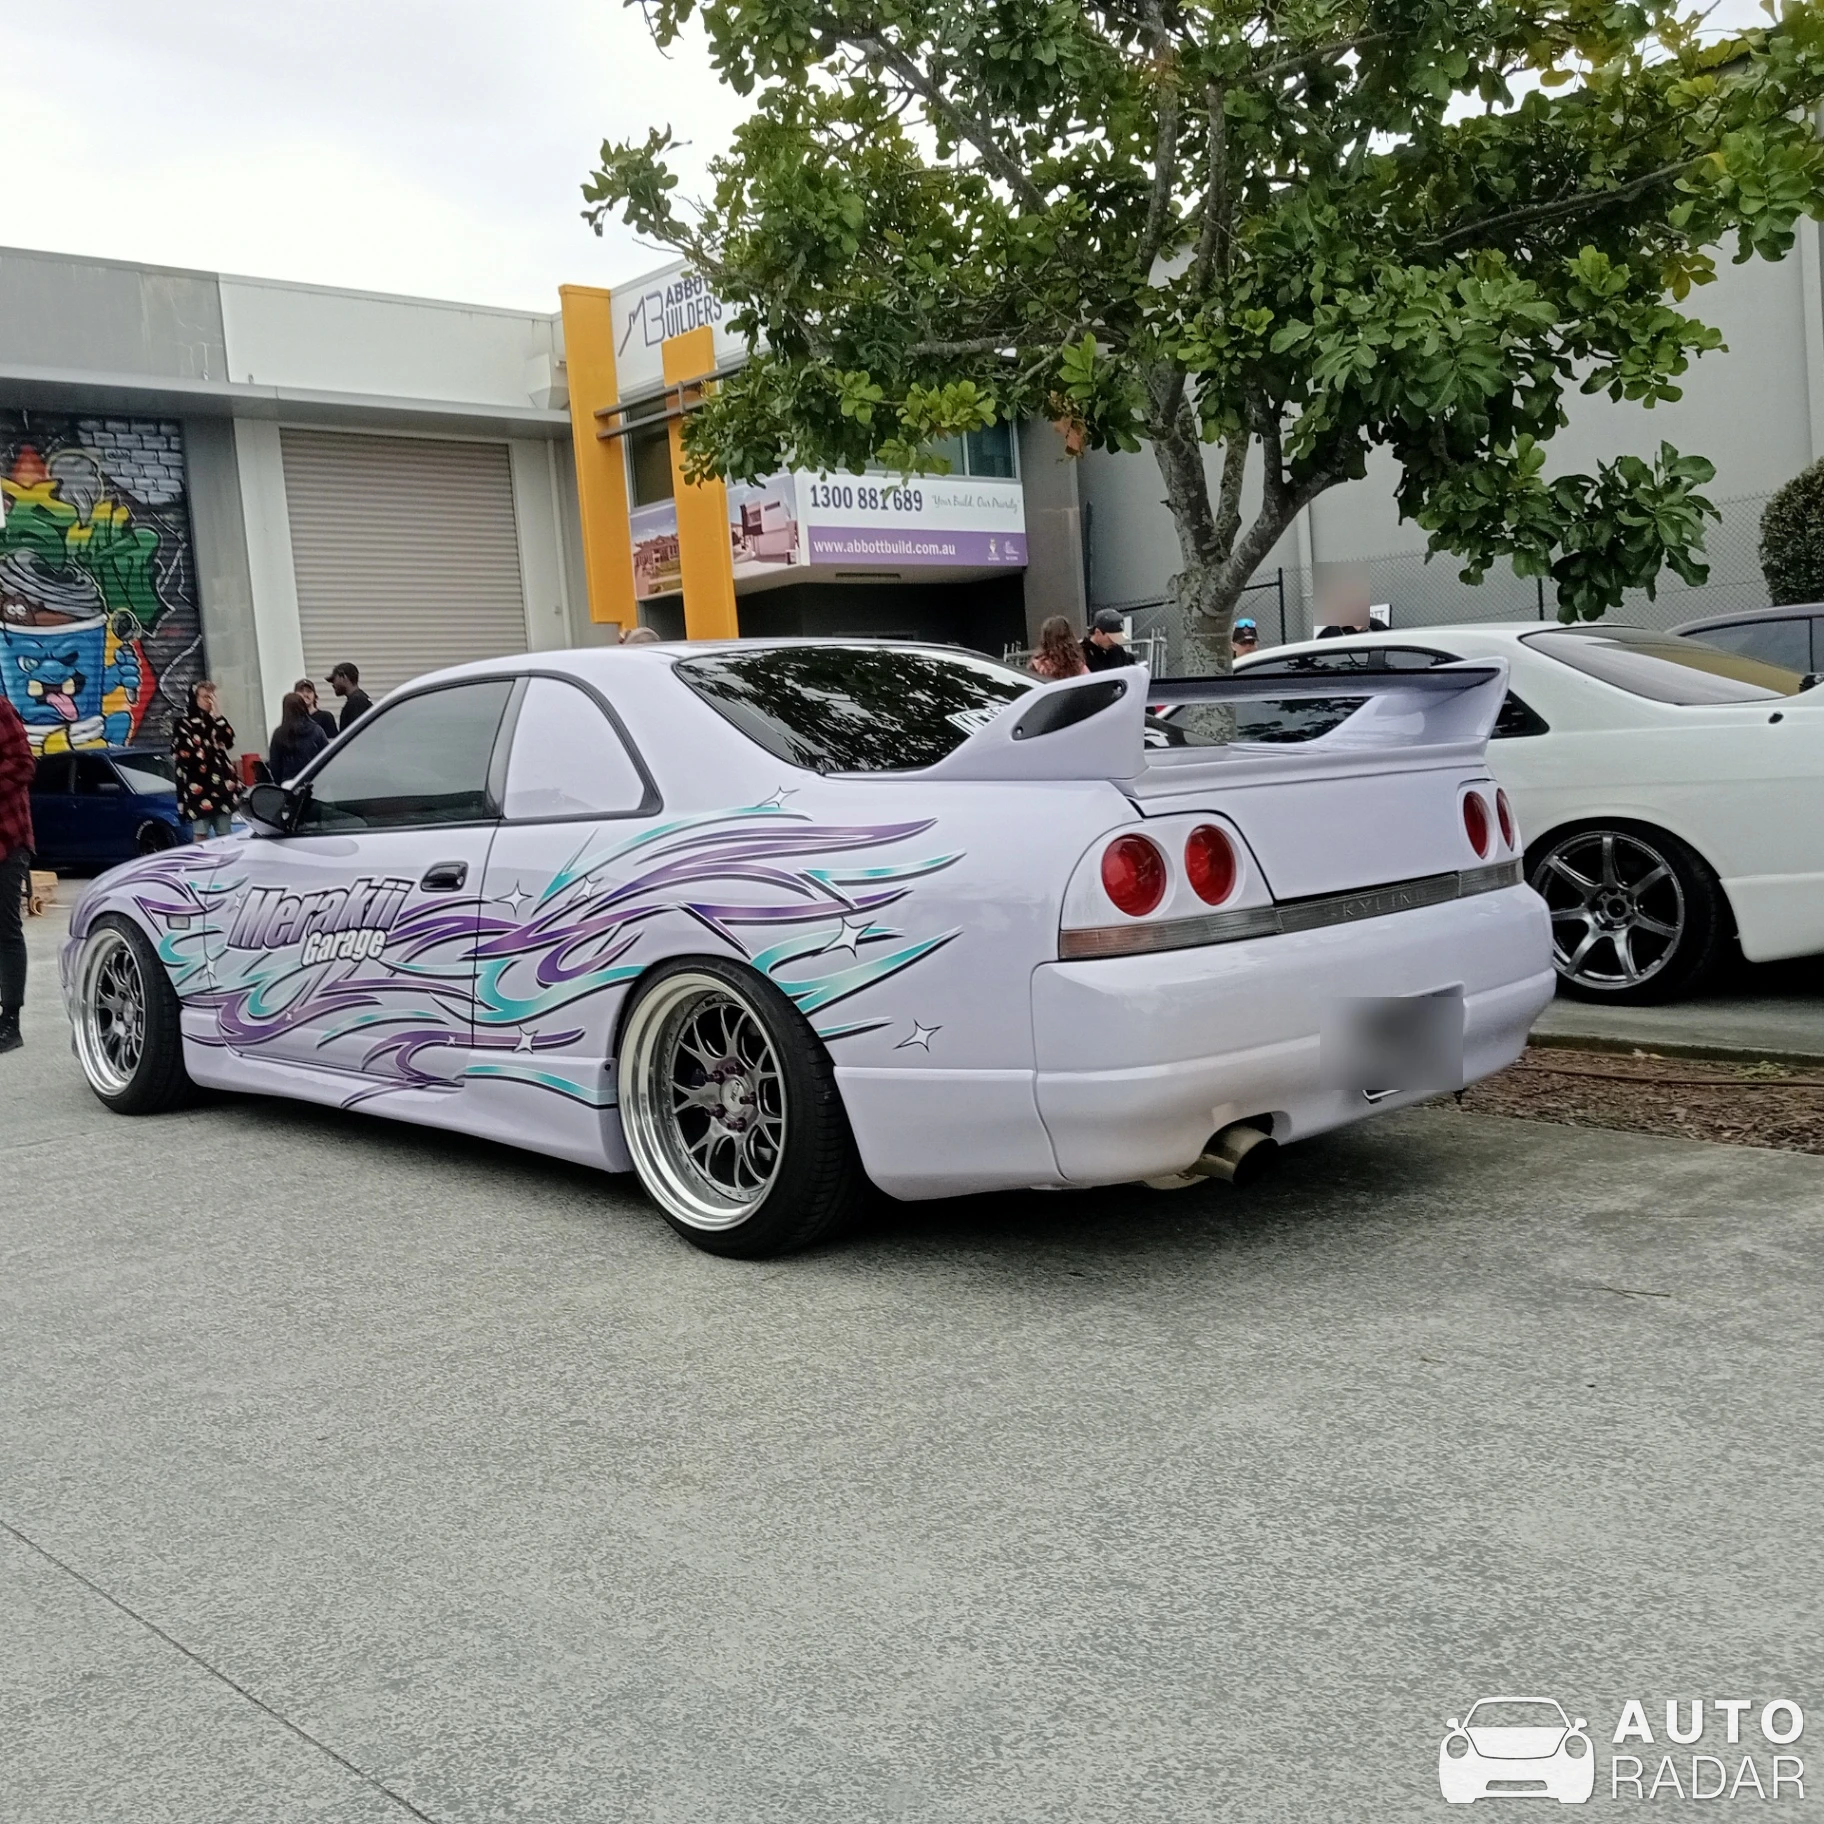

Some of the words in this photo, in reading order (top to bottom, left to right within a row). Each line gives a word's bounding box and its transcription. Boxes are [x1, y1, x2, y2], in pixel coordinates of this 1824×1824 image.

[811, 485, 853, 508] 1300
[858, 487, 888, 510] 881
[893, 489, 922, 511] 689
[814, 539, 956, 555] www.abbottbuild.com.au
[226, 878, 415, 949] Merakii
[301, 929, 386, 965] Garage
